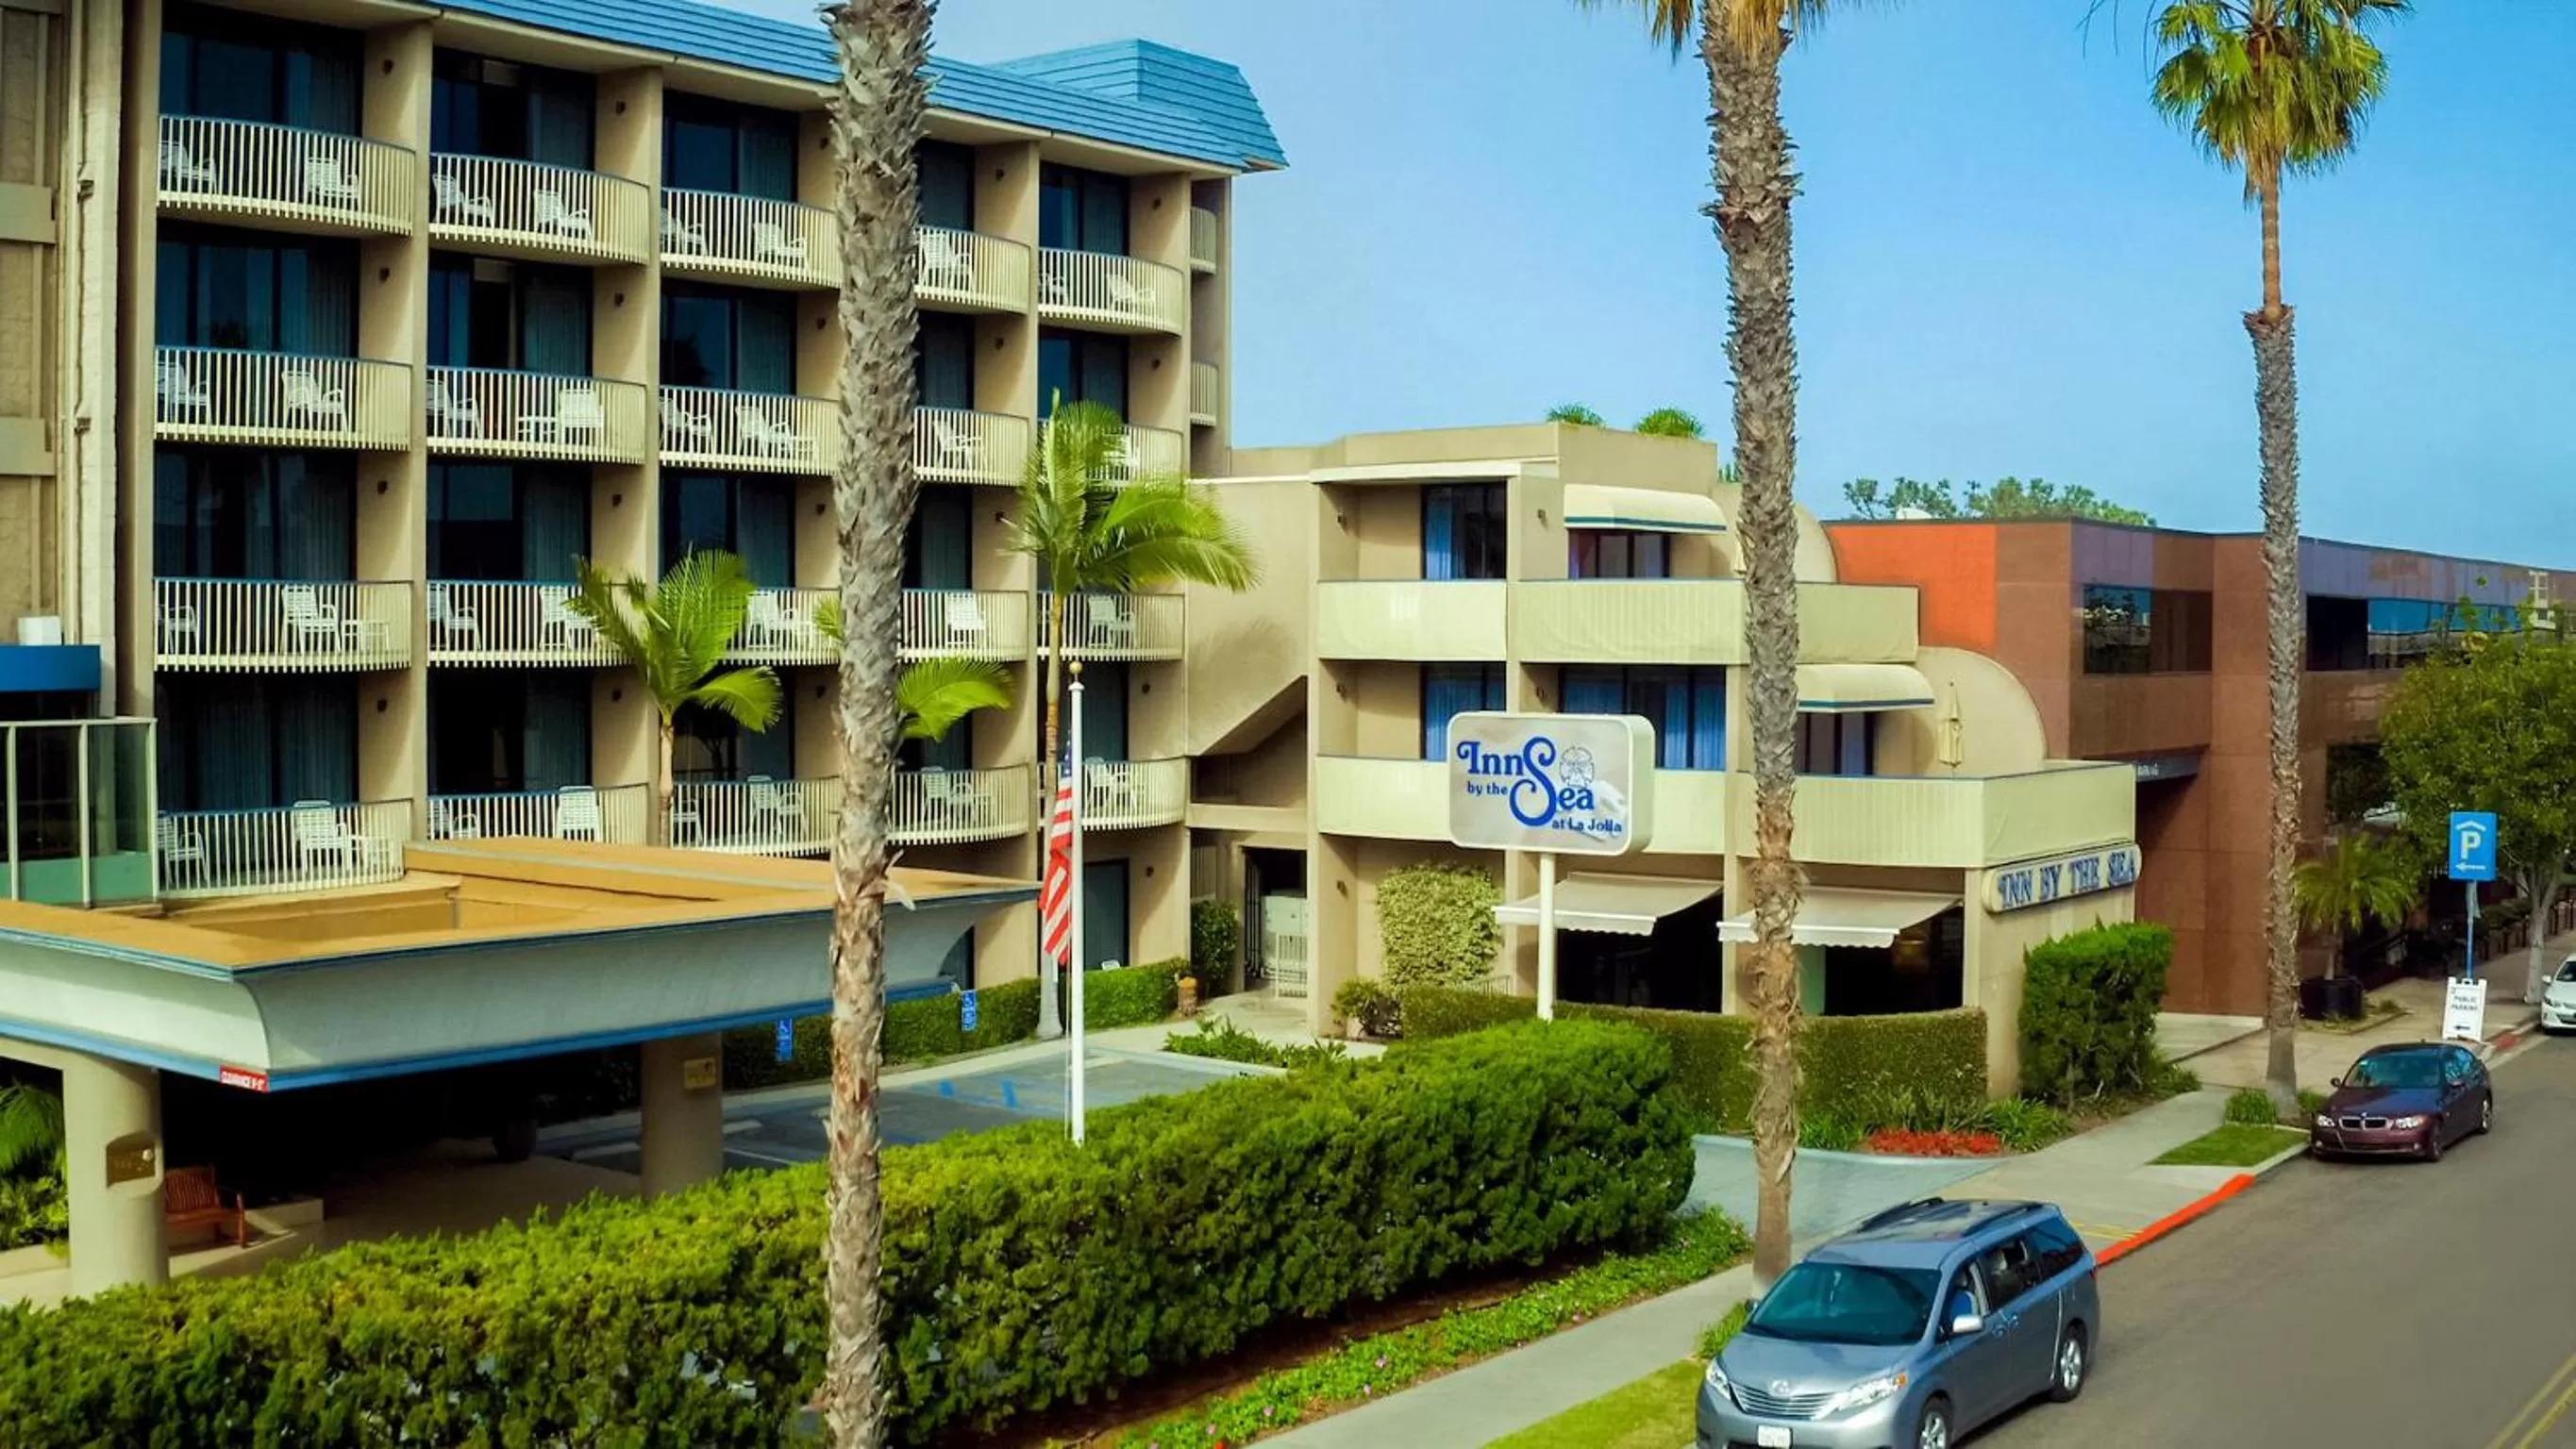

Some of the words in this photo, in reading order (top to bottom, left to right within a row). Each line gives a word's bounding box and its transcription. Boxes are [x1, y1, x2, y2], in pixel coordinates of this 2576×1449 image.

[1457, 741, 1524, 776] Inn
[1466, 781, 1482, 797] by
[1486, 783, 1508, 795] the
[1510, 736, 1595, 827] Sea
[1551, 819, 1565, 830] at
[1568, 819, 1584, 832] La
[1587, 818, 1623, 834] Jolla
[2460, 830, 2482, 859] P
[1998, 870, 2033, 908] INN
[2038, 864, 2063, 902] BY
[2068, 857, 2100, 894] THE
[2108, 849, 2136, 887] SEA
